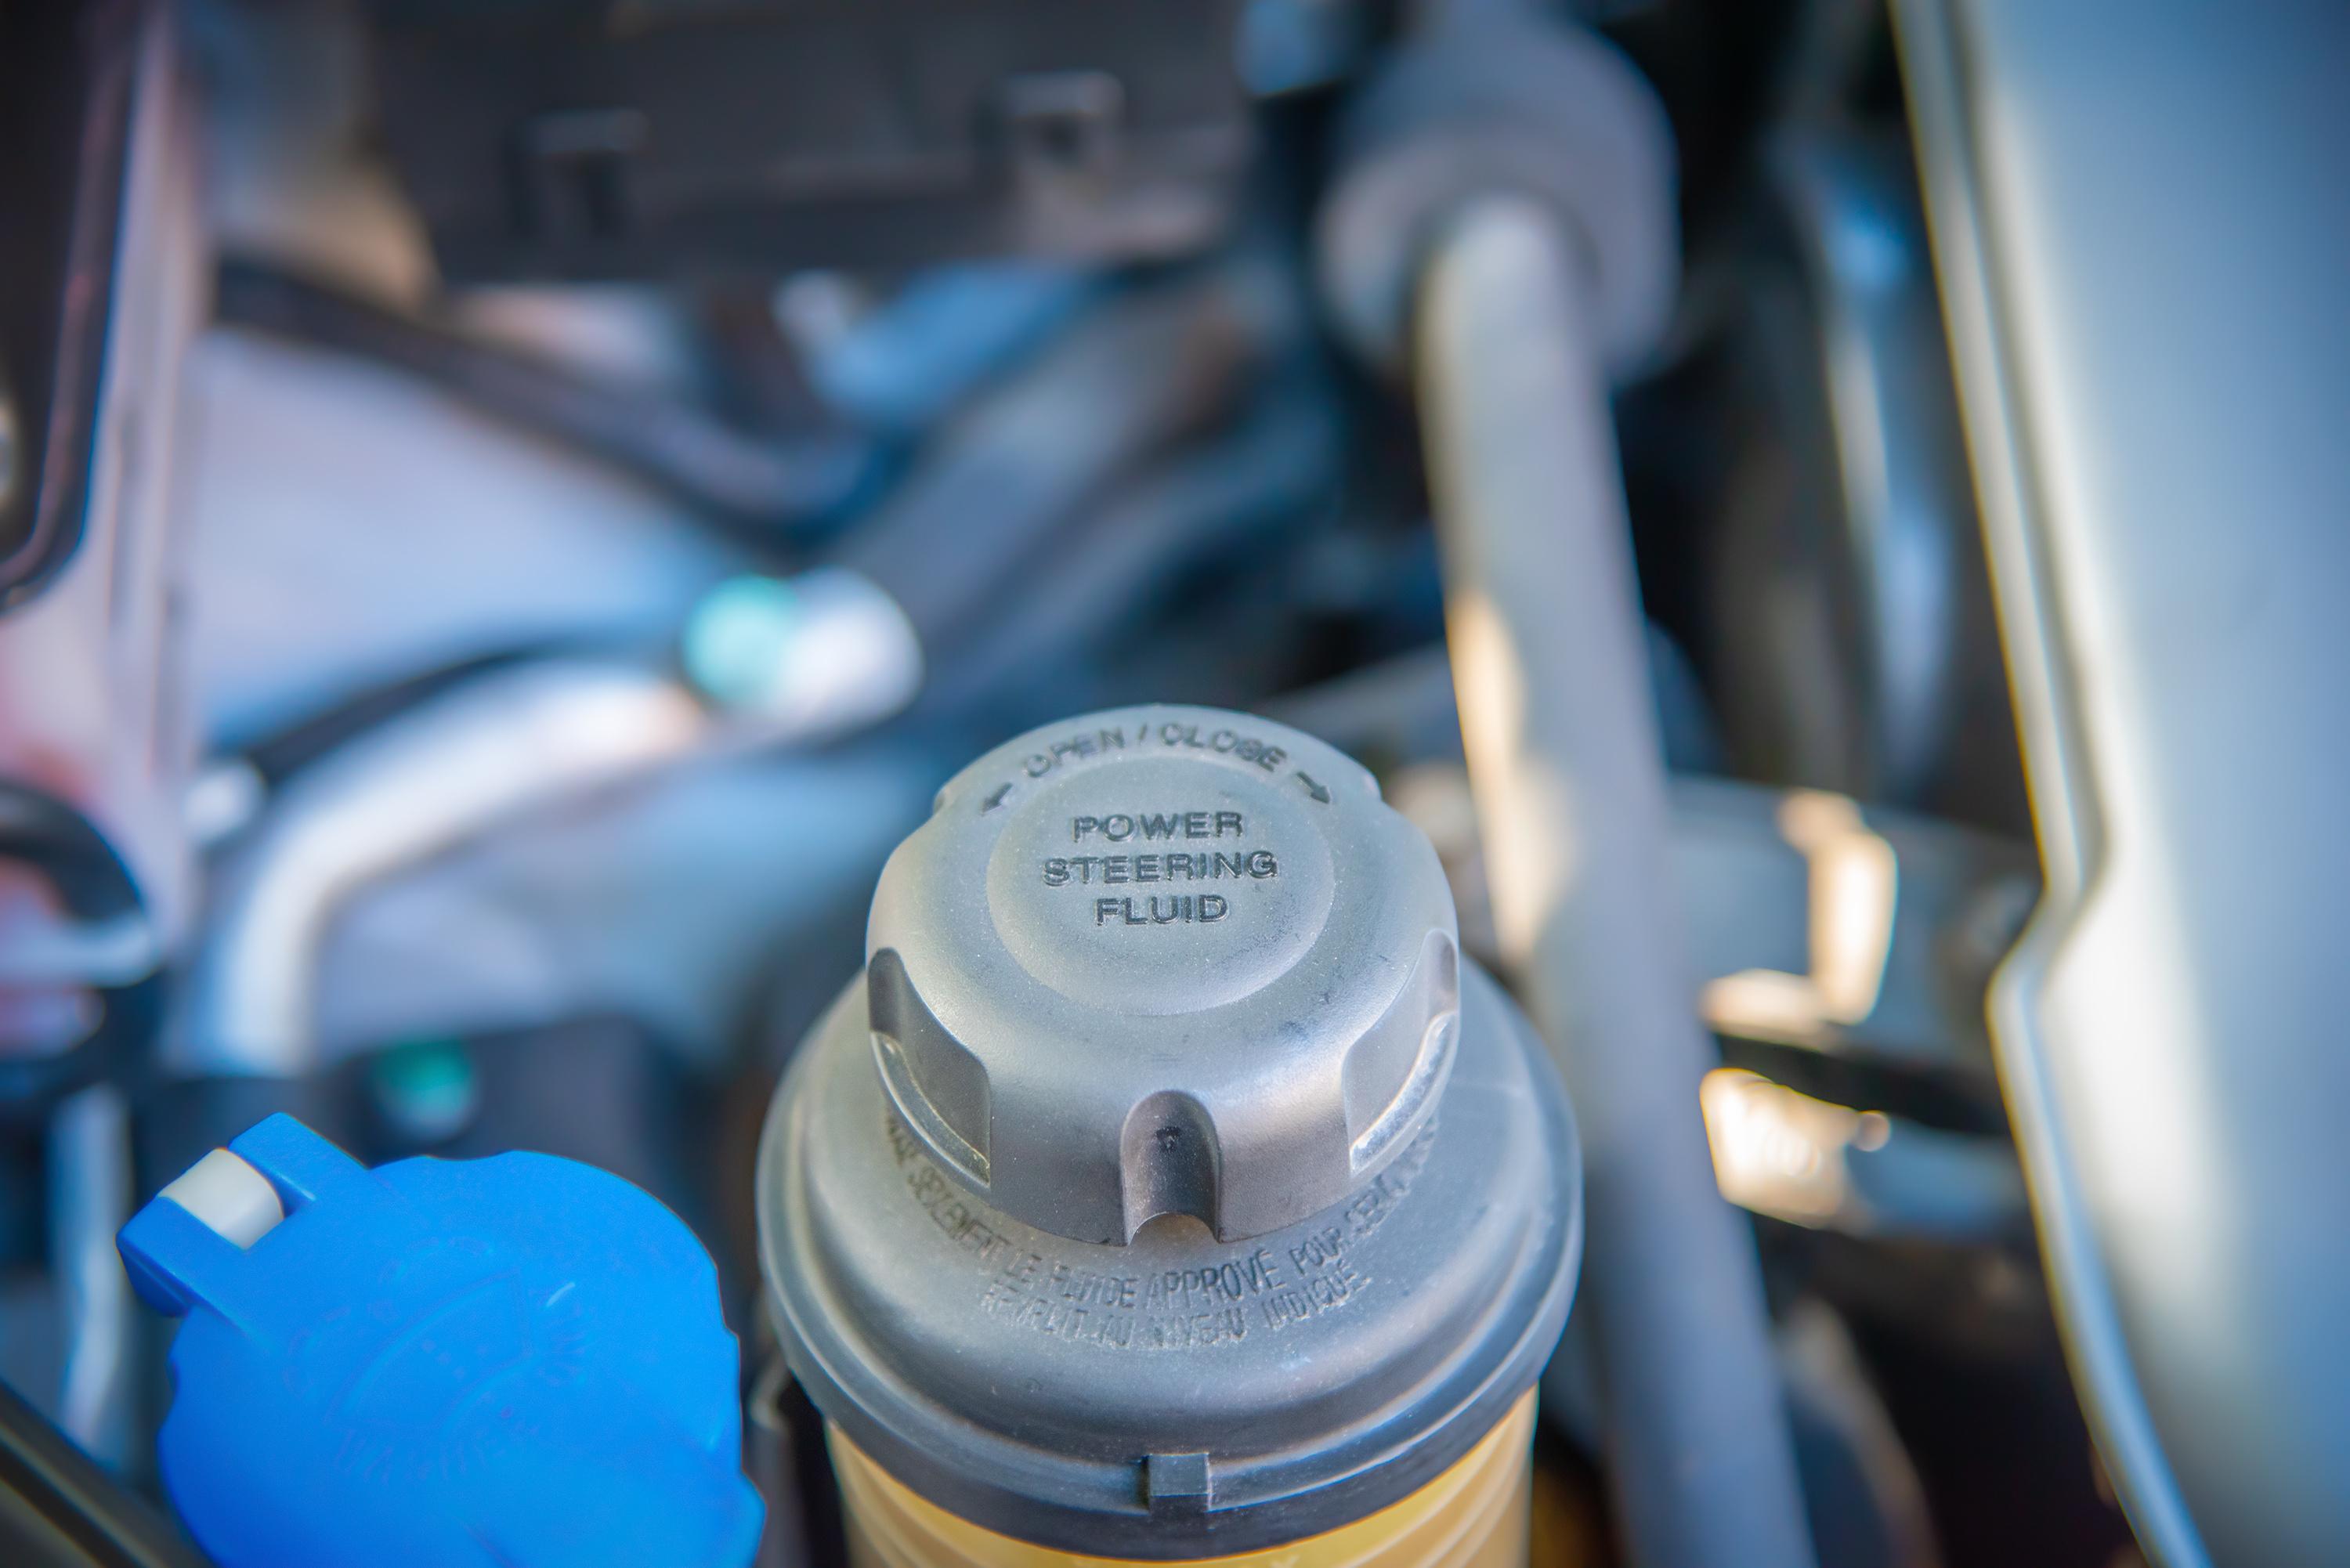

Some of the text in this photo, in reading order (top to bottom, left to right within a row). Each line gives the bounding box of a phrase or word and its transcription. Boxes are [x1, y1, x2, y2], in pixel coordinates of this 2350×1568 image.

[1021, 726, 1126, 778] OPEN
[1159, 721, 1288, 773] CLOSE
[1072, 811, 1245, 844] POWER
[1042, 849, 1279, 887] STEERING
[1095, 894, 1229, 927] FLUID
